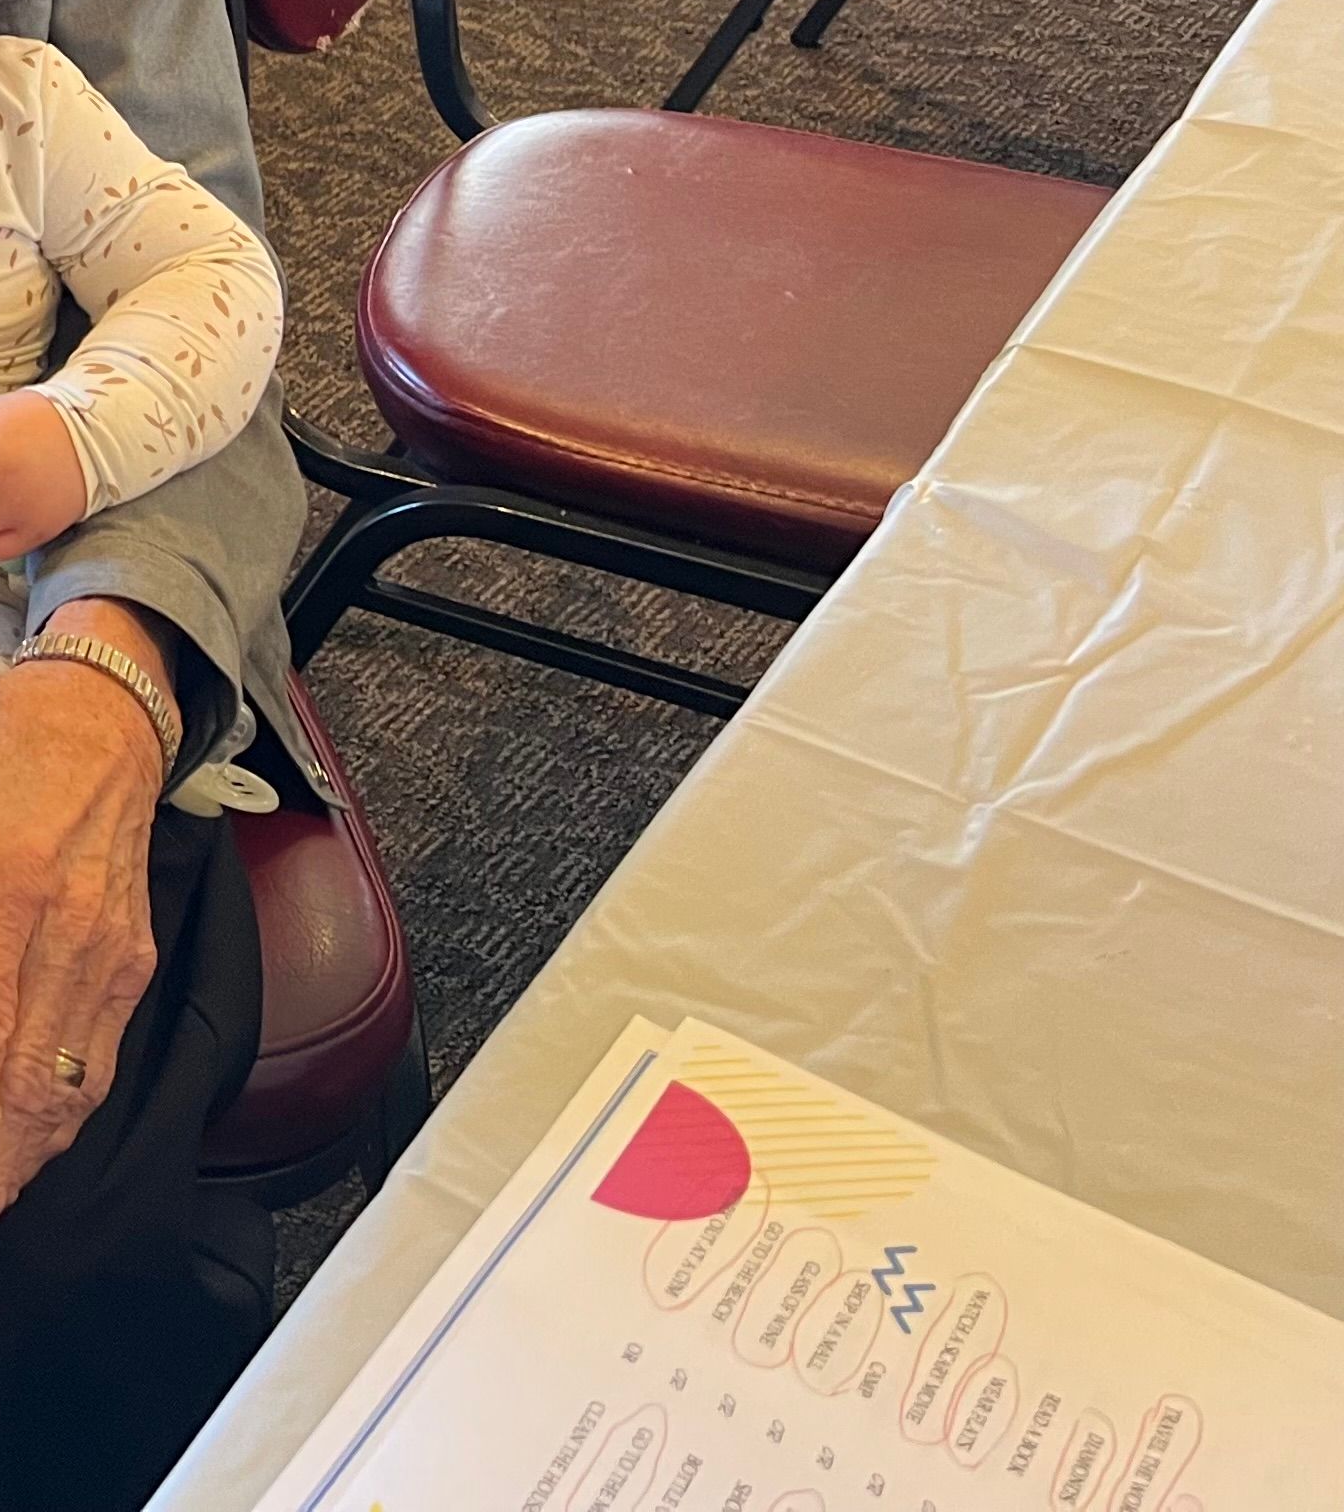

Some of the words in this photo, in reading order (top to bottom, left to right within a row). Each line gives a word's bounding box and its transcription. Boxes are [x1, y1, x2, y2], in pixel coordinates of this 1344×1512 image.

[697, 1215, 724, 1245] OUT
[662, 1267, 691, 1299] GYM
[734, 1256, 761, 1285] THE
[787, 1258, 822, 1299] GLASS
[709, 1280, 745, 1324] BEACH
[840, 1278, 871, 1315] SHOP
[954, 1286, 990, 1333] WATCH
[757, 1308, 791, 1350] WINE
[804, 1335, 836, 1374] MALL
[927, 1342, 960, 1383] SCARY
[854, 1358, 887, 1401] CAMP
[974, 1373, 1007, 1414] WEAR
[565, 1396, 607, 1446] CLEAN
[903, 1379, 939, 1426] MOVIE
[549, 1440, 580, 1474] THE
[1006, 1436, 1037, 1478] BOOK
[1058, 1431, 1105, 1506] DIAMONDS
[597, 1467, 628, 1502] THE
[659, 1451, 704, 1509] BOTTLE
